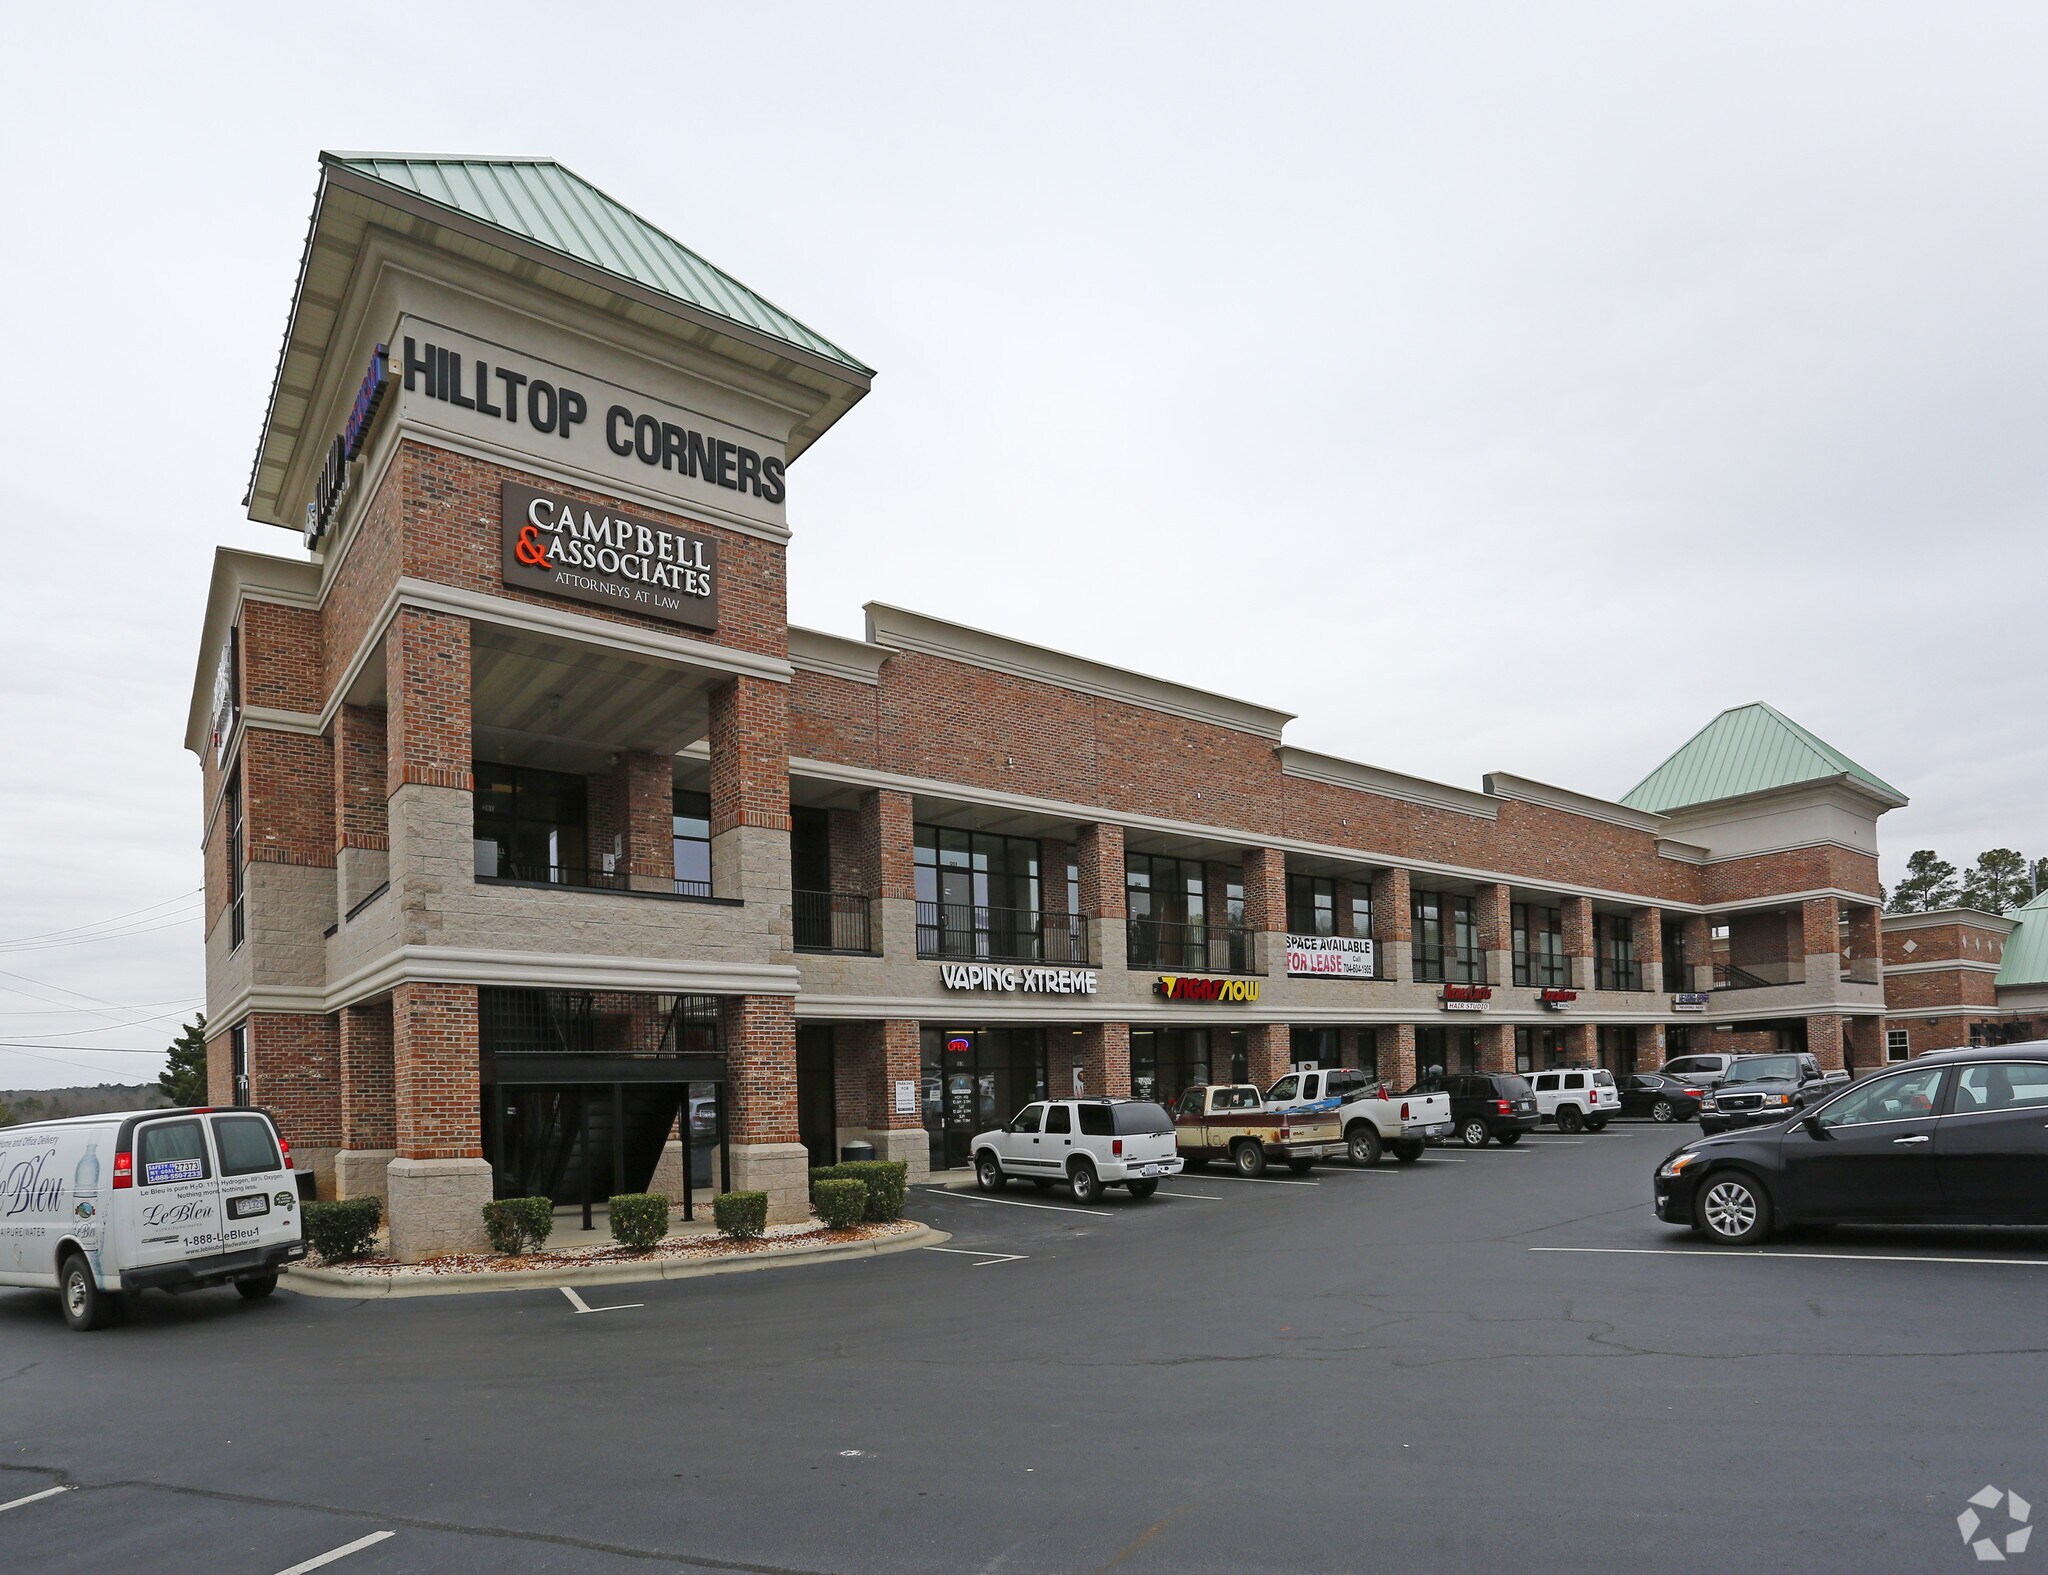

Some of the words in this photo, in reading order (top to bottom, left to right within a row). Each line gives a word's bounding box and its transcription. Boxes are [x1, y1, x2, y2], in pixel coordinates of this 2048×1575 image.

[403, 336, 587, 439] HILLTOP
[606, 404, 786, 504] CORNERS
[528, 498, 711, 571] CAMPBELL
[515, 525, 553, 569] &
[546, 535, 711, 597] ASSOCIATES
[555, 572, 631, 599] ATTORNEYS
[634, 590, 650, 603] AT
[654, 595, 680, 610] LAW
[1286, 936, 1317, 950] SPACE
[1320, 938, 1370, 954] AVAILABLE
[1287, 952, 1307, 971] FOR
[1310, 953, 1342, 973] LEASE
[941, 964, 1016, 992] VAPING
[1022, 968, 1098, 994] XTREME
[948, 1042, 967, 1051] OPEN
[176, 1162, 199, 1171] 27373
[177, 1191, 202, 1199] Nothing
[222, 1184, 244, 1193] Nothing
[183, 1227, 260, 1247] 1-888-LeBleu-1
